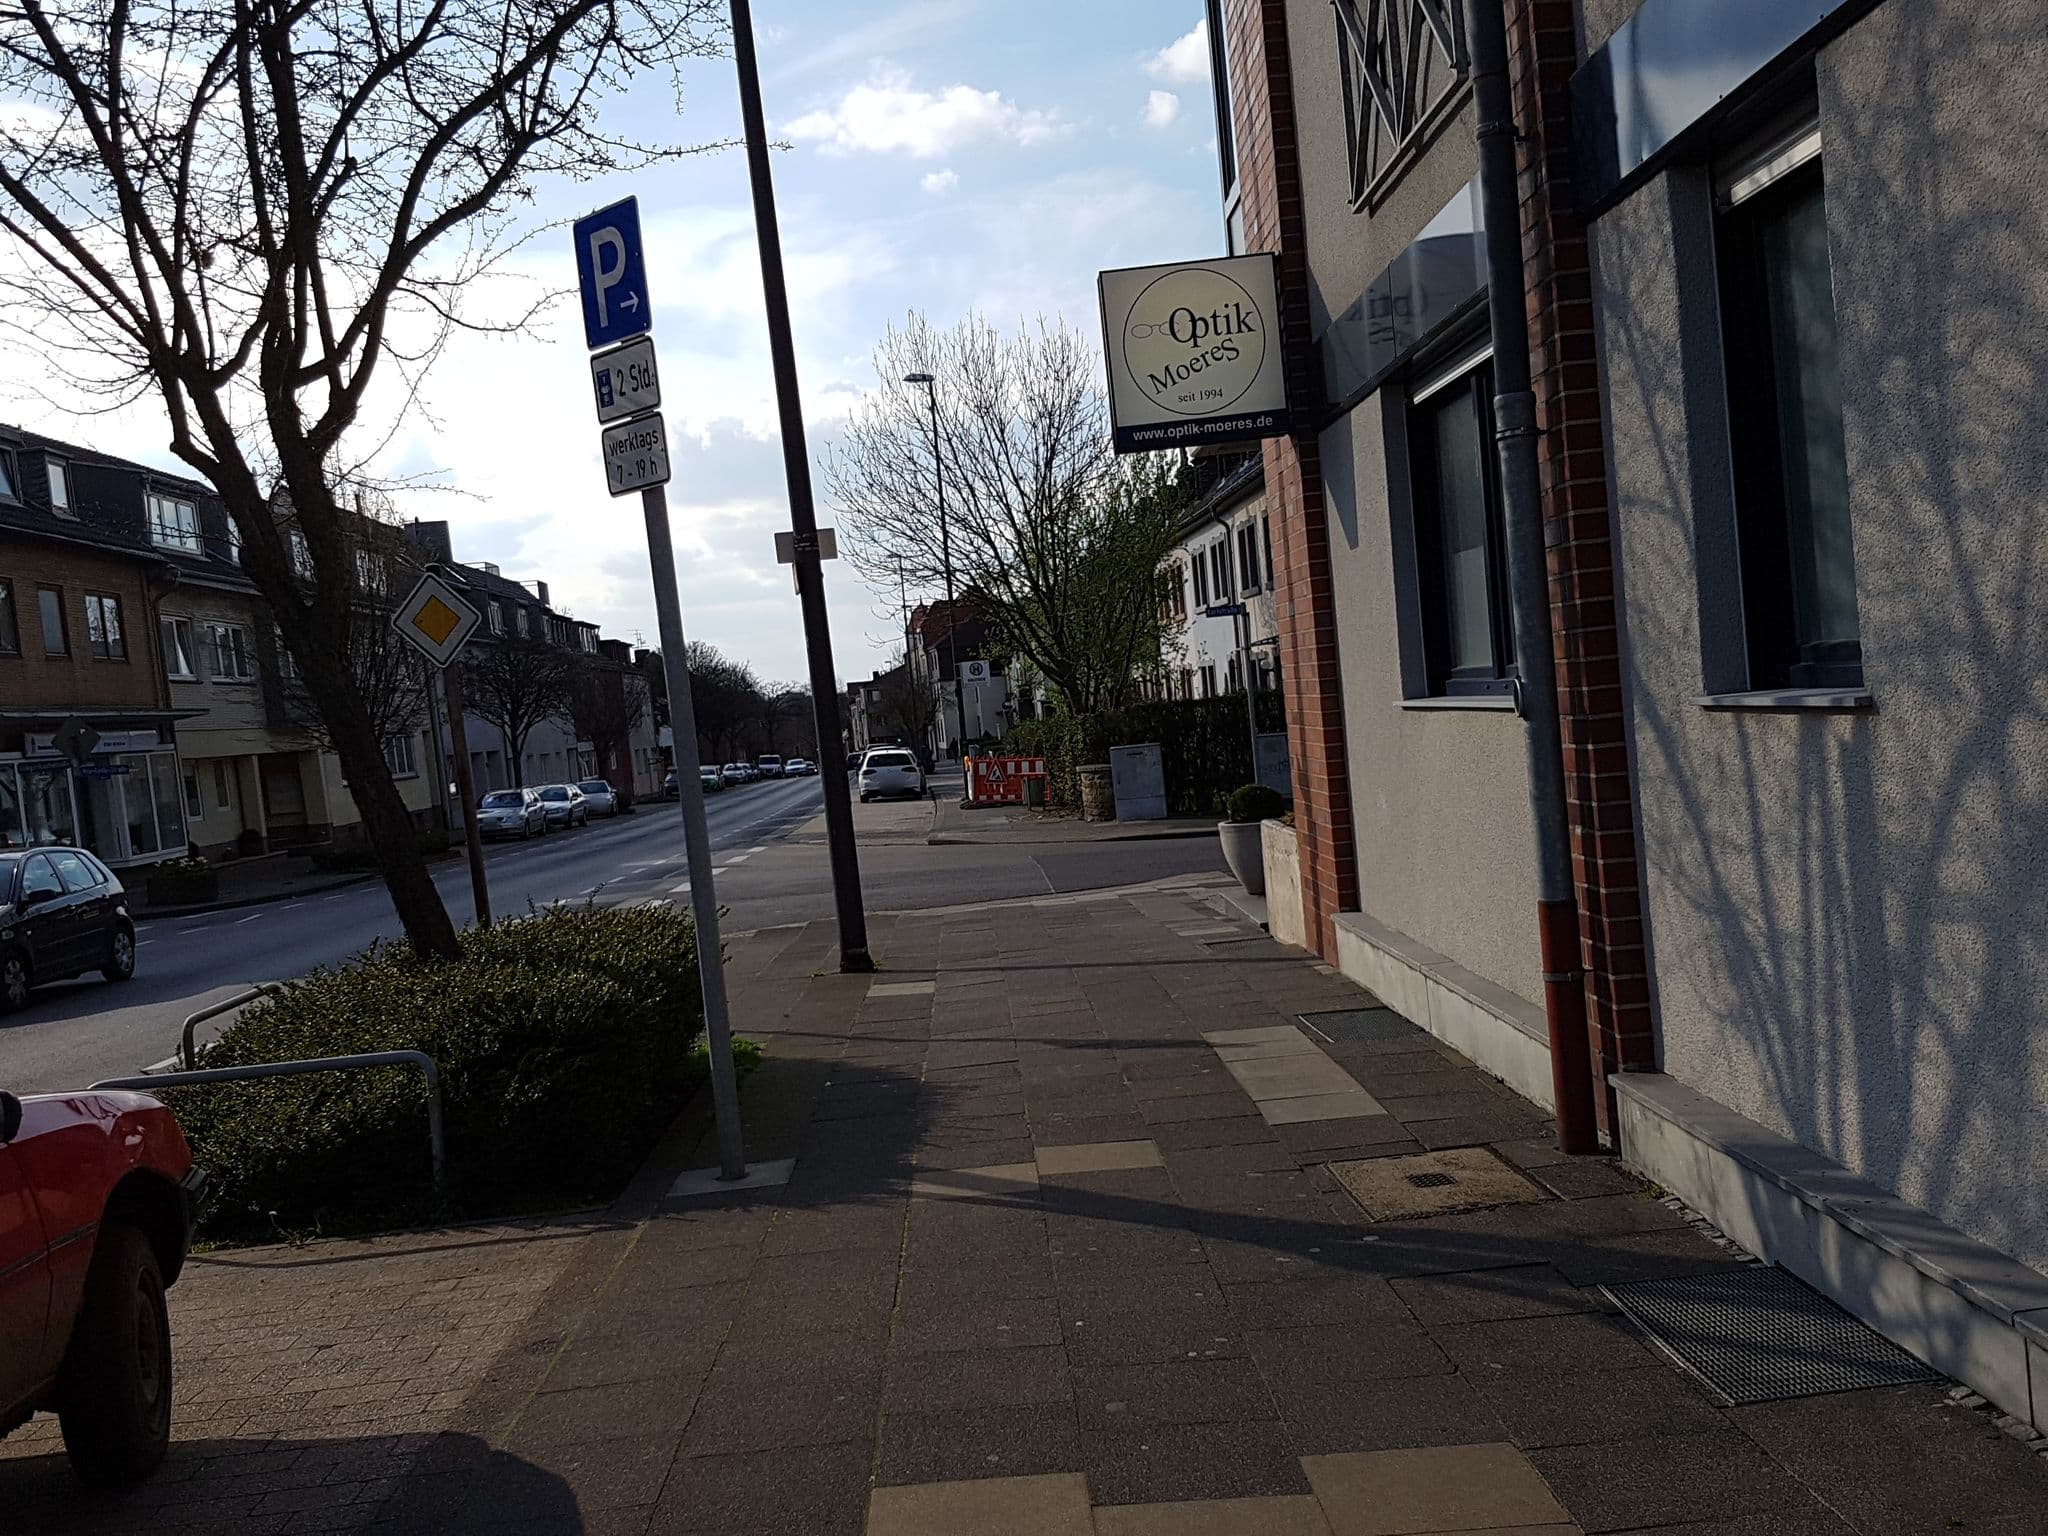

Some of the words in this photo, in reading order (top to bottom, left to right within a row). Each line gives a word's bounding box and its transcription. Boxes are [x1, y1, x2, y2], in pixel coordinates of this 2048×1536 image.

[590, 226, 627, 328] P
[1168, 302, 1257, 349] Optik
[616, 368, 627, 397] 2
[1178, 391, 1196, 403] seit
[1200, 388, 1224, 401] 1994
[1132, 415, 1273, 441] www.optik-moeres.de
[608, 430, 659, 457] werktags
[616, 464, 623, 485] 7
[635, 458, 646, 479] 19
[649, 455, 658, 475] h
